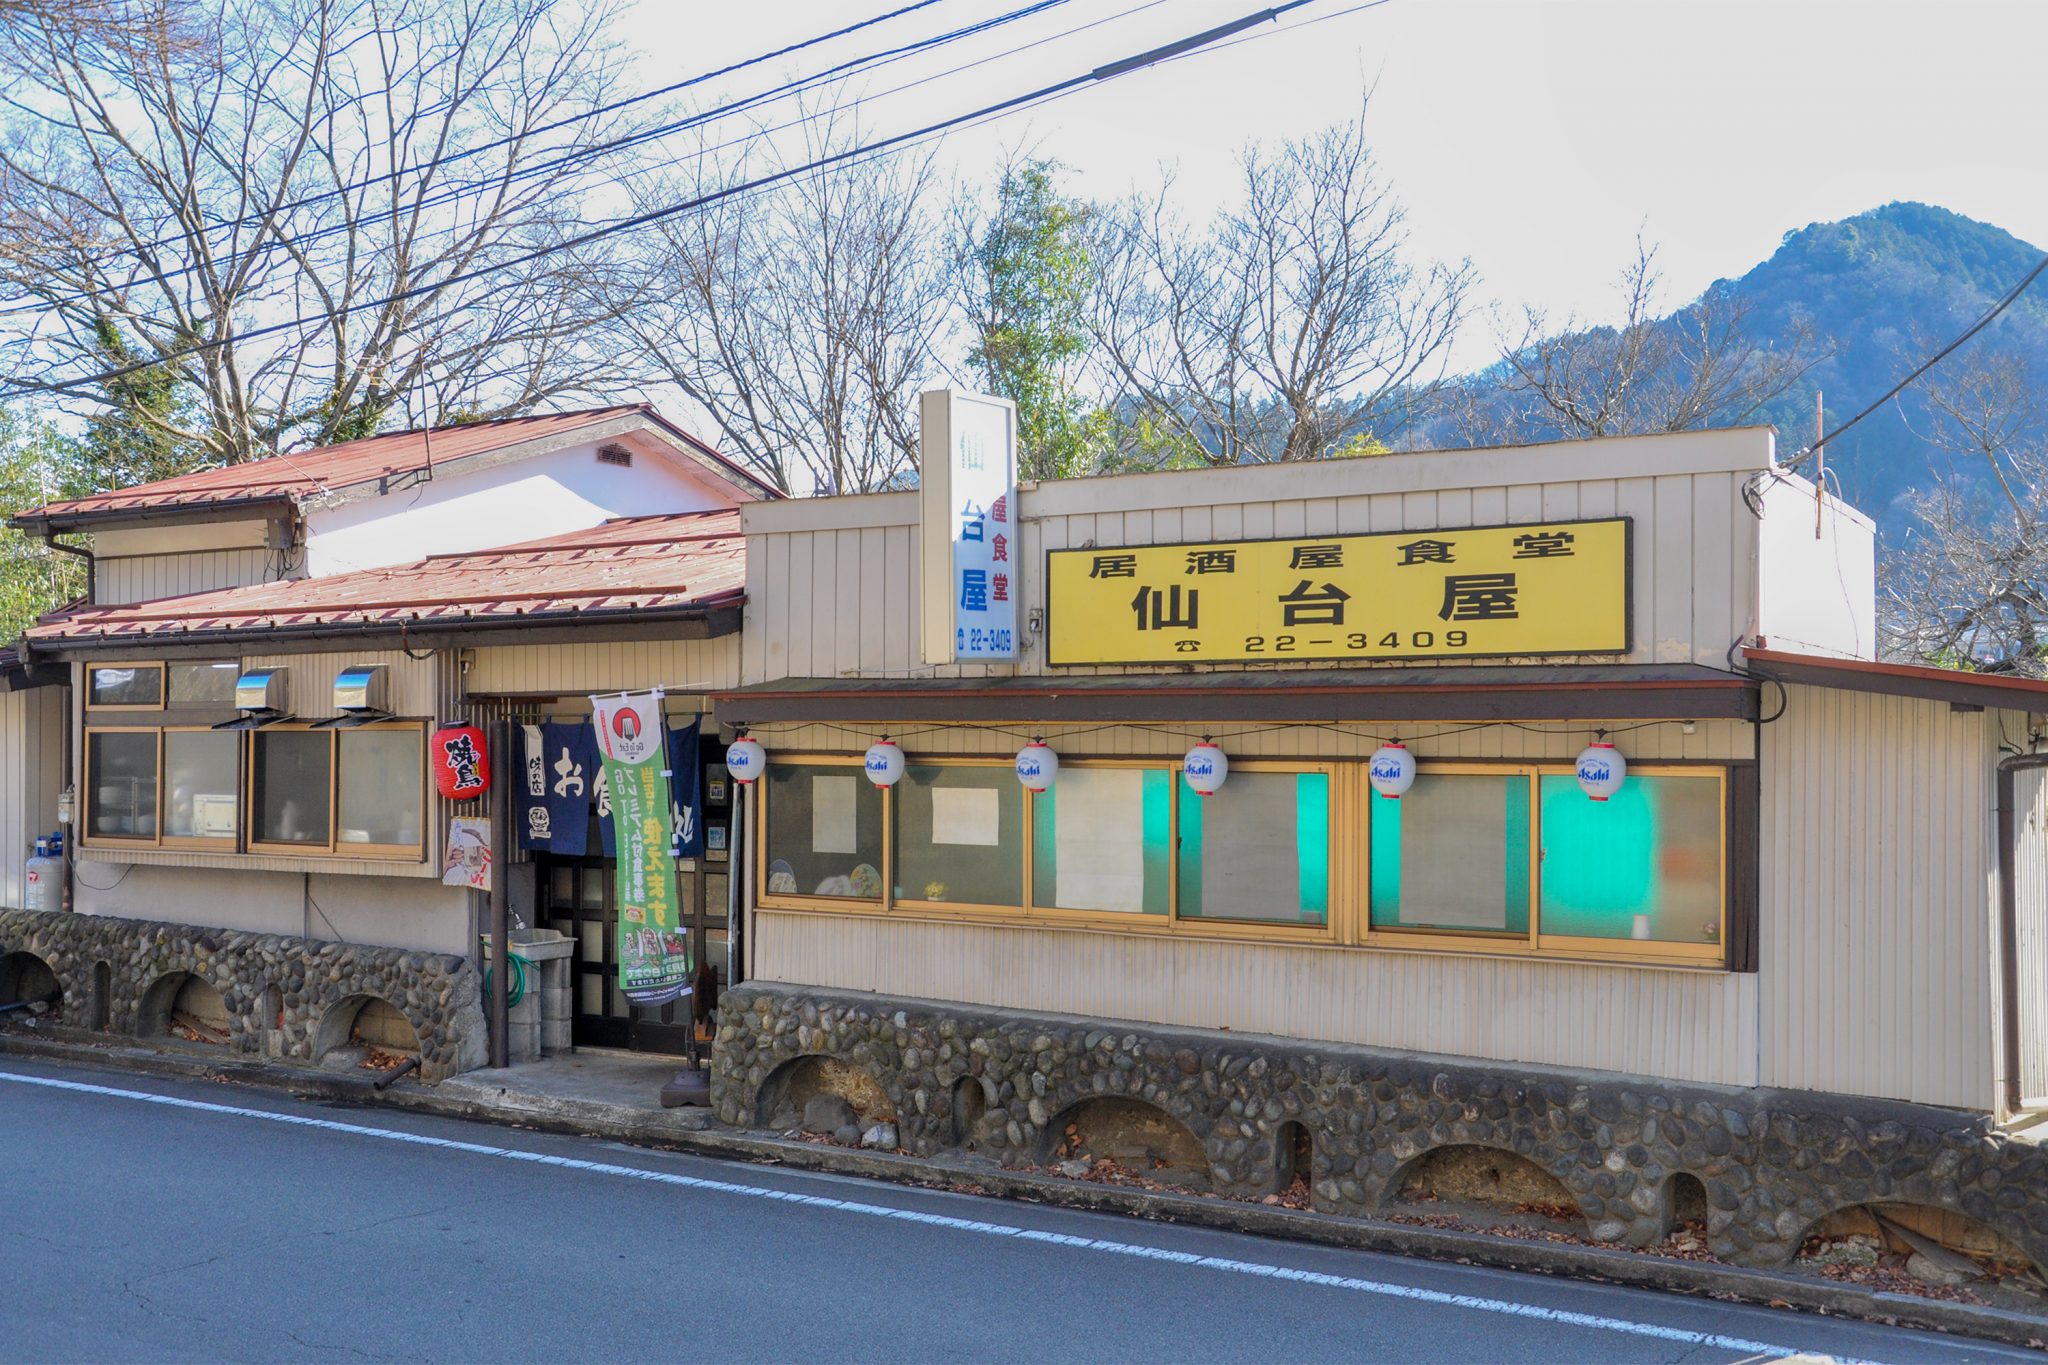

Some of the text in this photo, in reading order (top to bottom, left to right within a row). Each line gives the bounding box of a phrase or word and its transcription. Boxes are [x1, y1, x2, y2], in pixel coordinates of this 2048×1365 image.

[1089, 531, 1576, 579] 居酒屋食堂
[1131, 571, 1520, 631] 仙台屋
[971, 628, 1011, 652] 22-3409
[1245, 630, 1469, 652] 22-3409
[444, 734, 484, 790] 焼鳥
[1185, 762, 1212, 775] Asahi
[1371, 764, 1400, 778] Asahi
[1578, 767, 1609, 781] Asahi
[530, 755, 543, 794] 味の店
